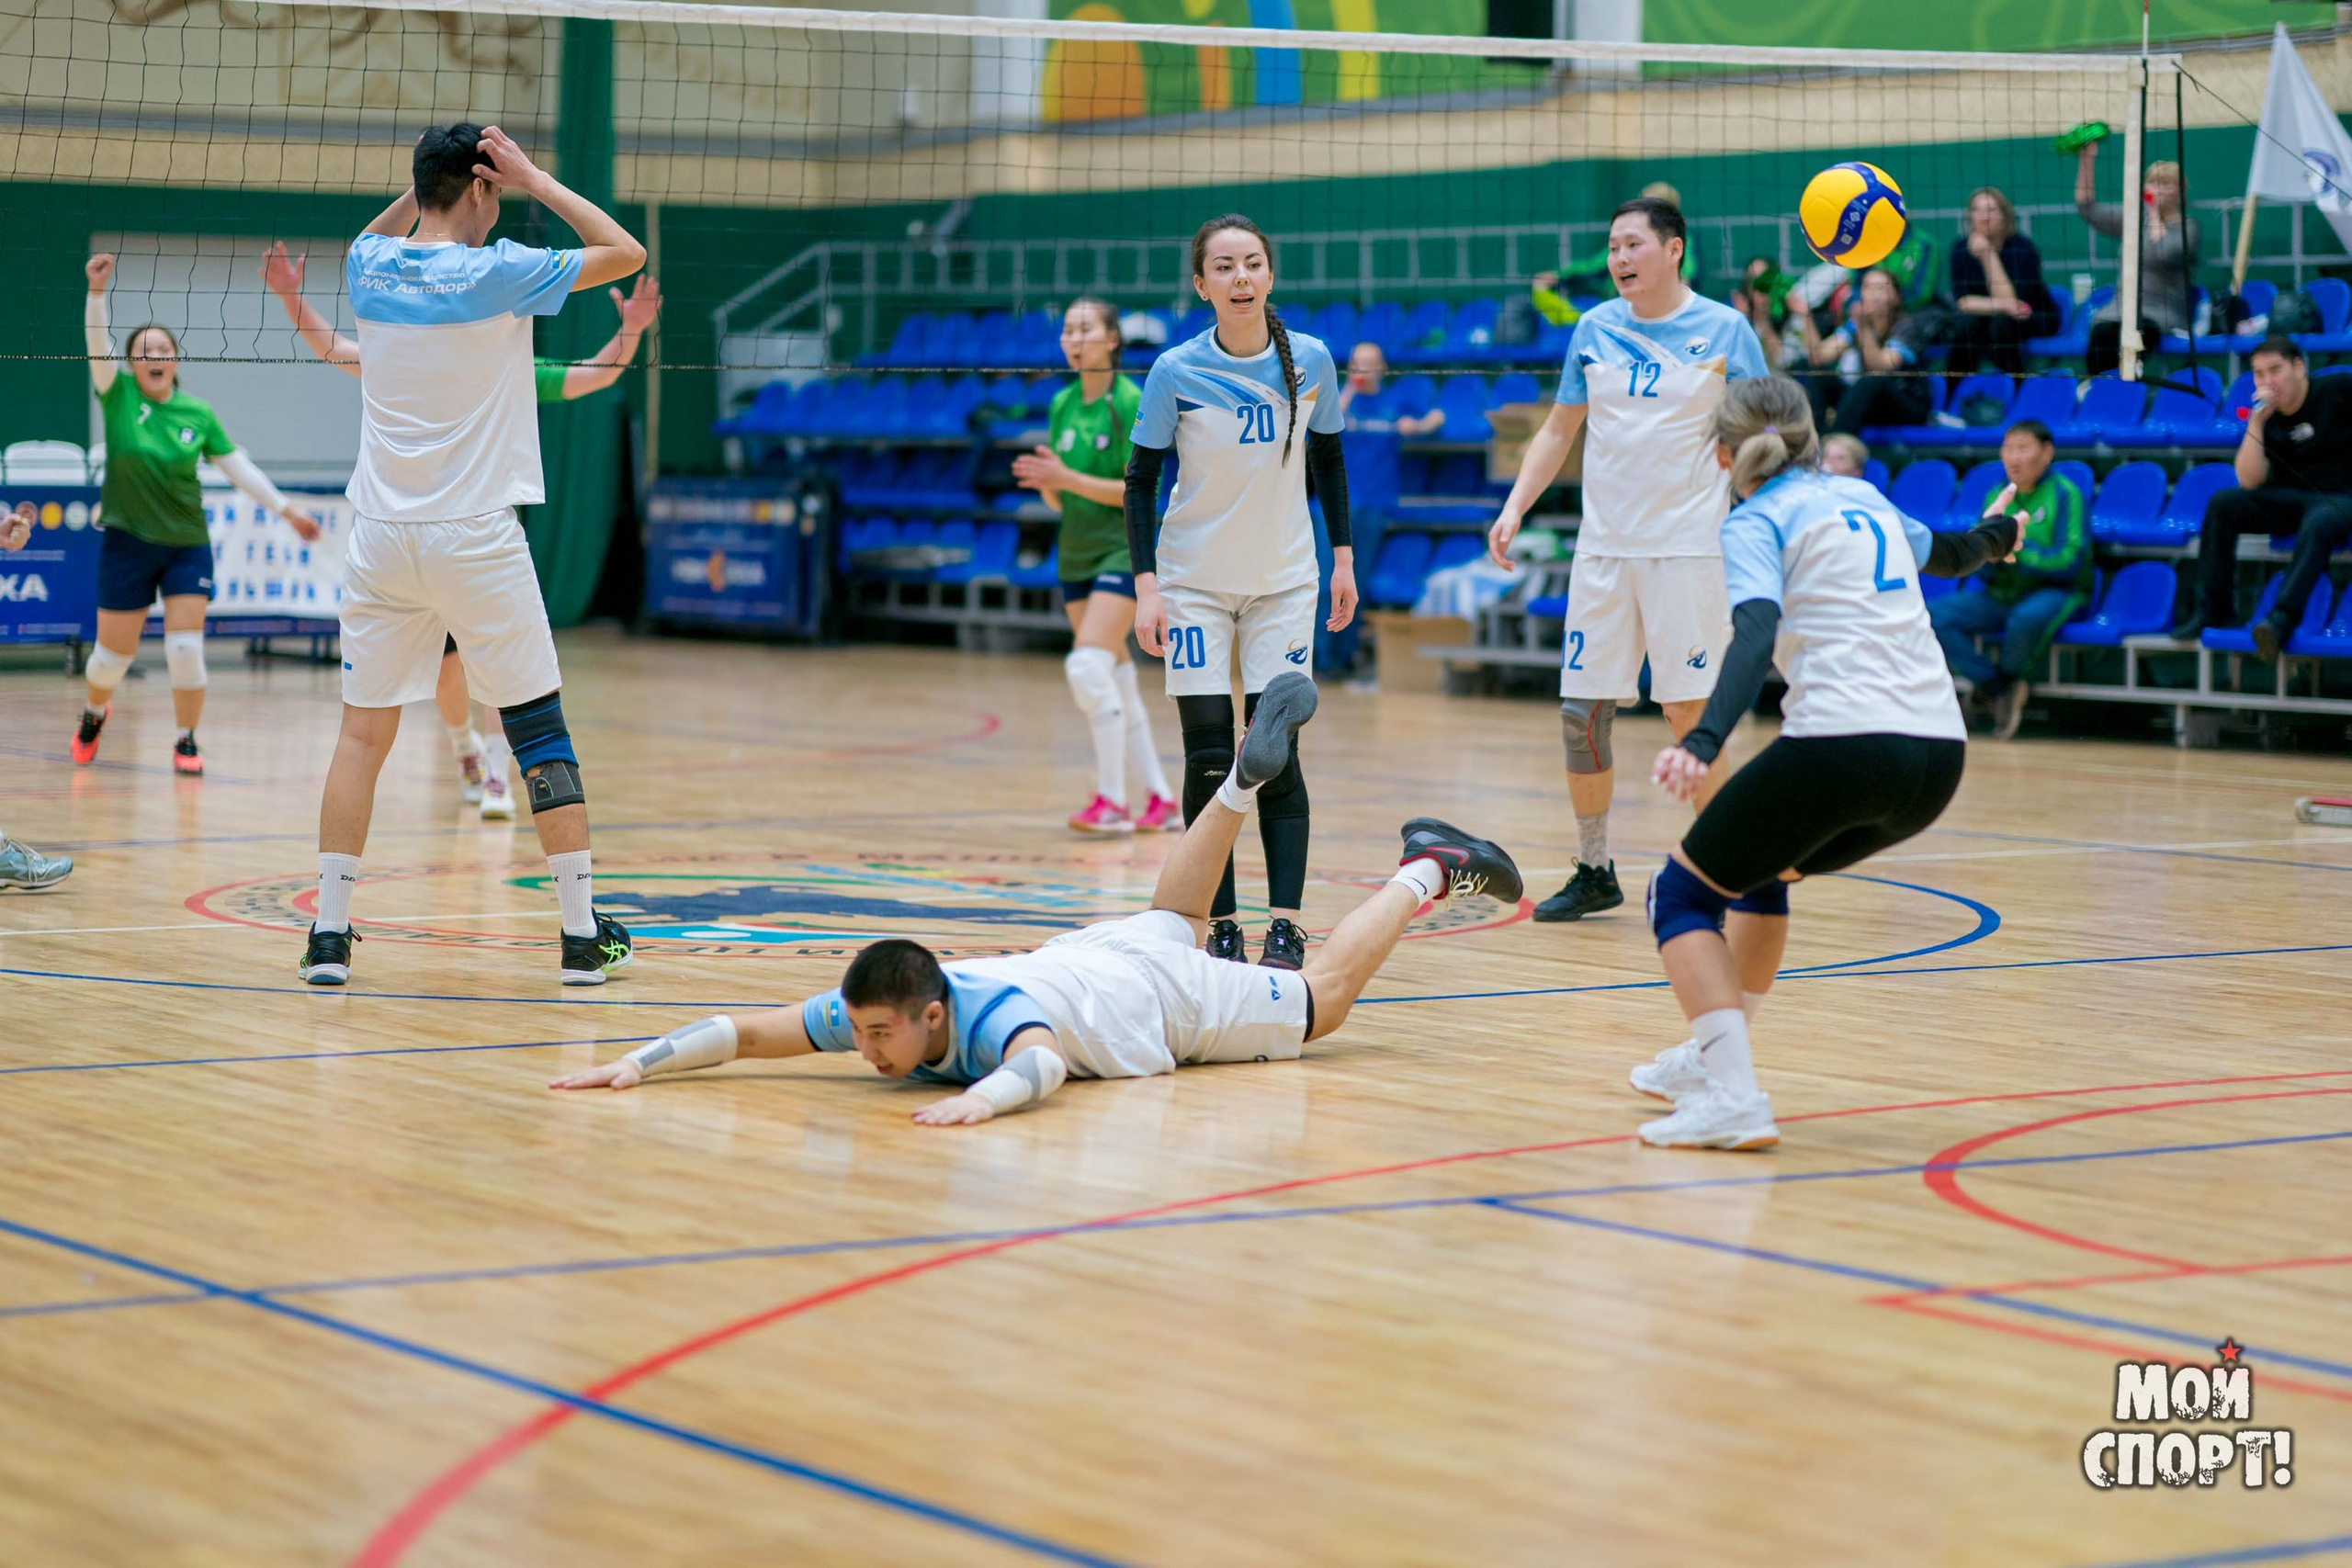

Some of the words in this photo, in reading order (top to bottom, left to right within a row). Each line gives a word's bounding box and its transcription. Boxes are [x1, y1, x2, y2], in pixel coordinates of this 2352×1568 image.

[1627, 361, 1661, 398] 12
[1237, 403, 1275, 444] 20
[1840, 510, 1906, 592] 2
[1169, 626, 1206, 670] 20
